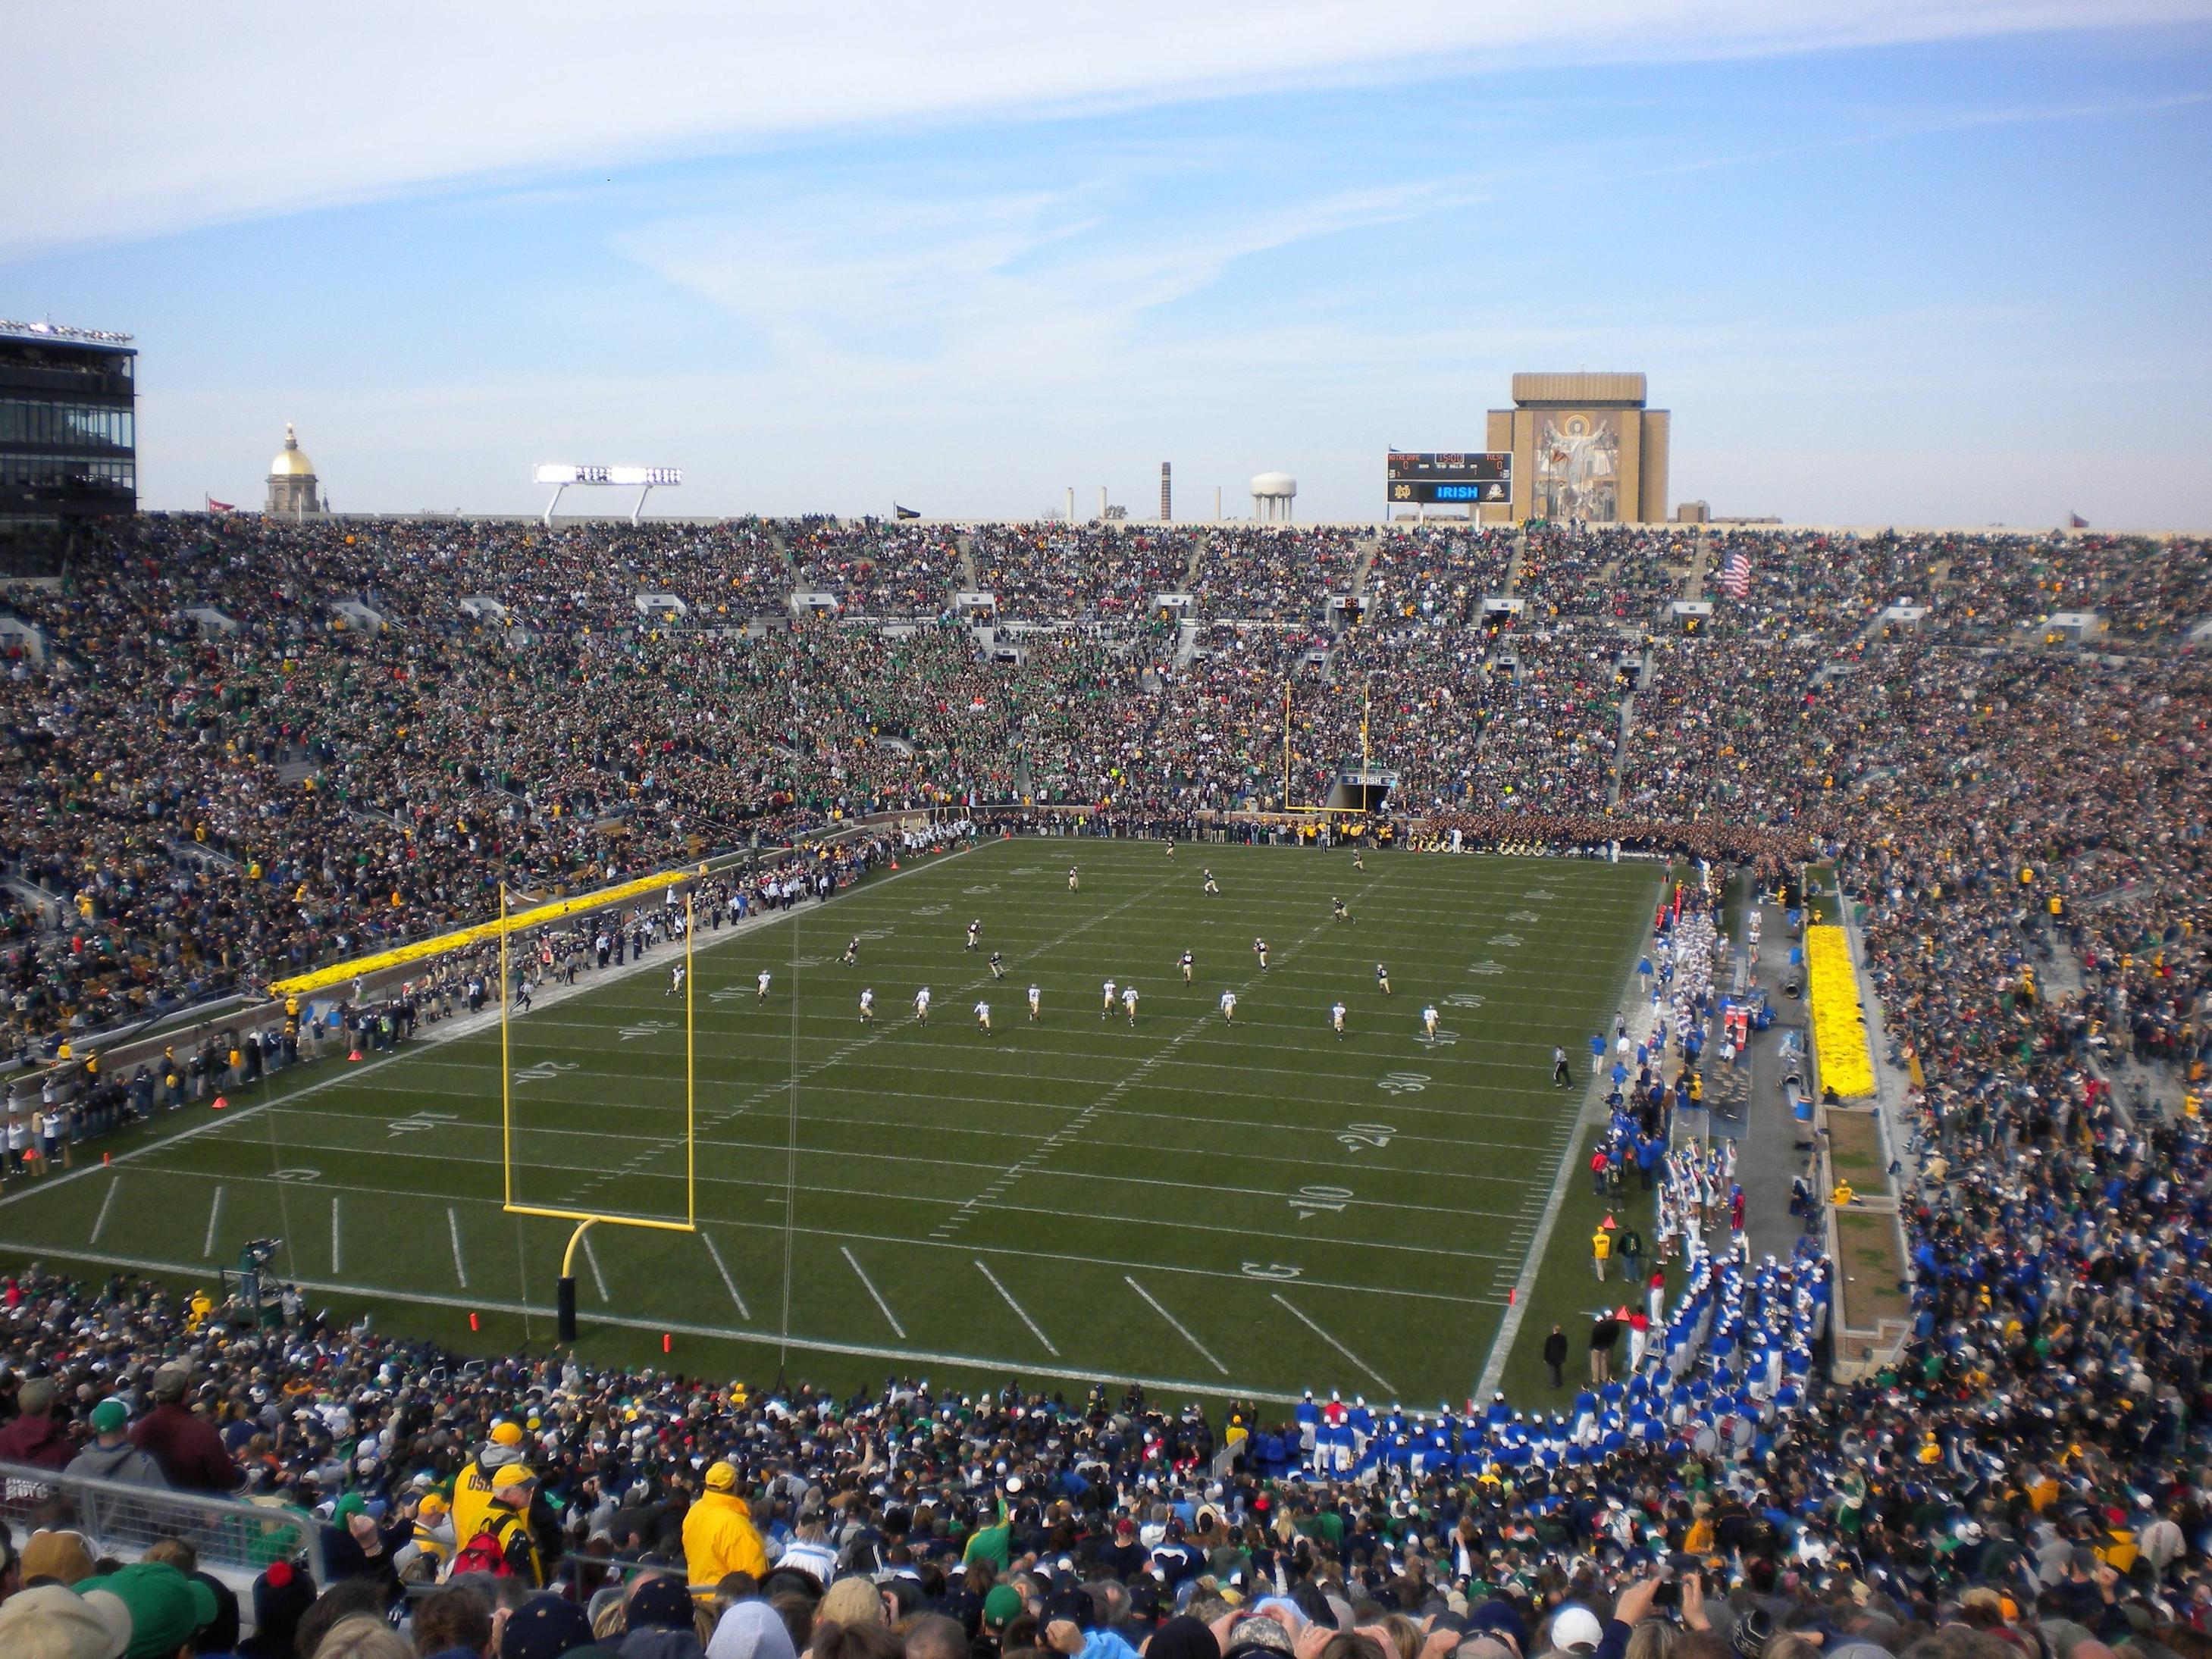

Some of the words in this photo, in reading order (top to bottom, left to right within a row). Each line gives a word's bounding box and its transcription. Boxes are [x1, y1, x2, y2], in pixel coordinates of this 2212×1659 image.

[1403, 461, 1408, 470] 0
[1439, 454, 1463, 462] 15:00
[1497, 461, 1502, 470] 0
[1437, 487, 1478, 498] IRISH
[1346, 598, 1358, 607] 25
[1441, 994, 1486, 1008] 50
[618, 1020, 678, 1038] 30
[515, 1061, 580, 1080] 20
[1377, 1072, 1431, 1092] 30
[387, 1110, 459, 1132] 10
[1336, 1124, 1397, 1147] 20
[267, 1168, 321, 1181] G
[1288, 1186, 1354, 1213] 10
[1242, 1261, 1305, 1279] G
